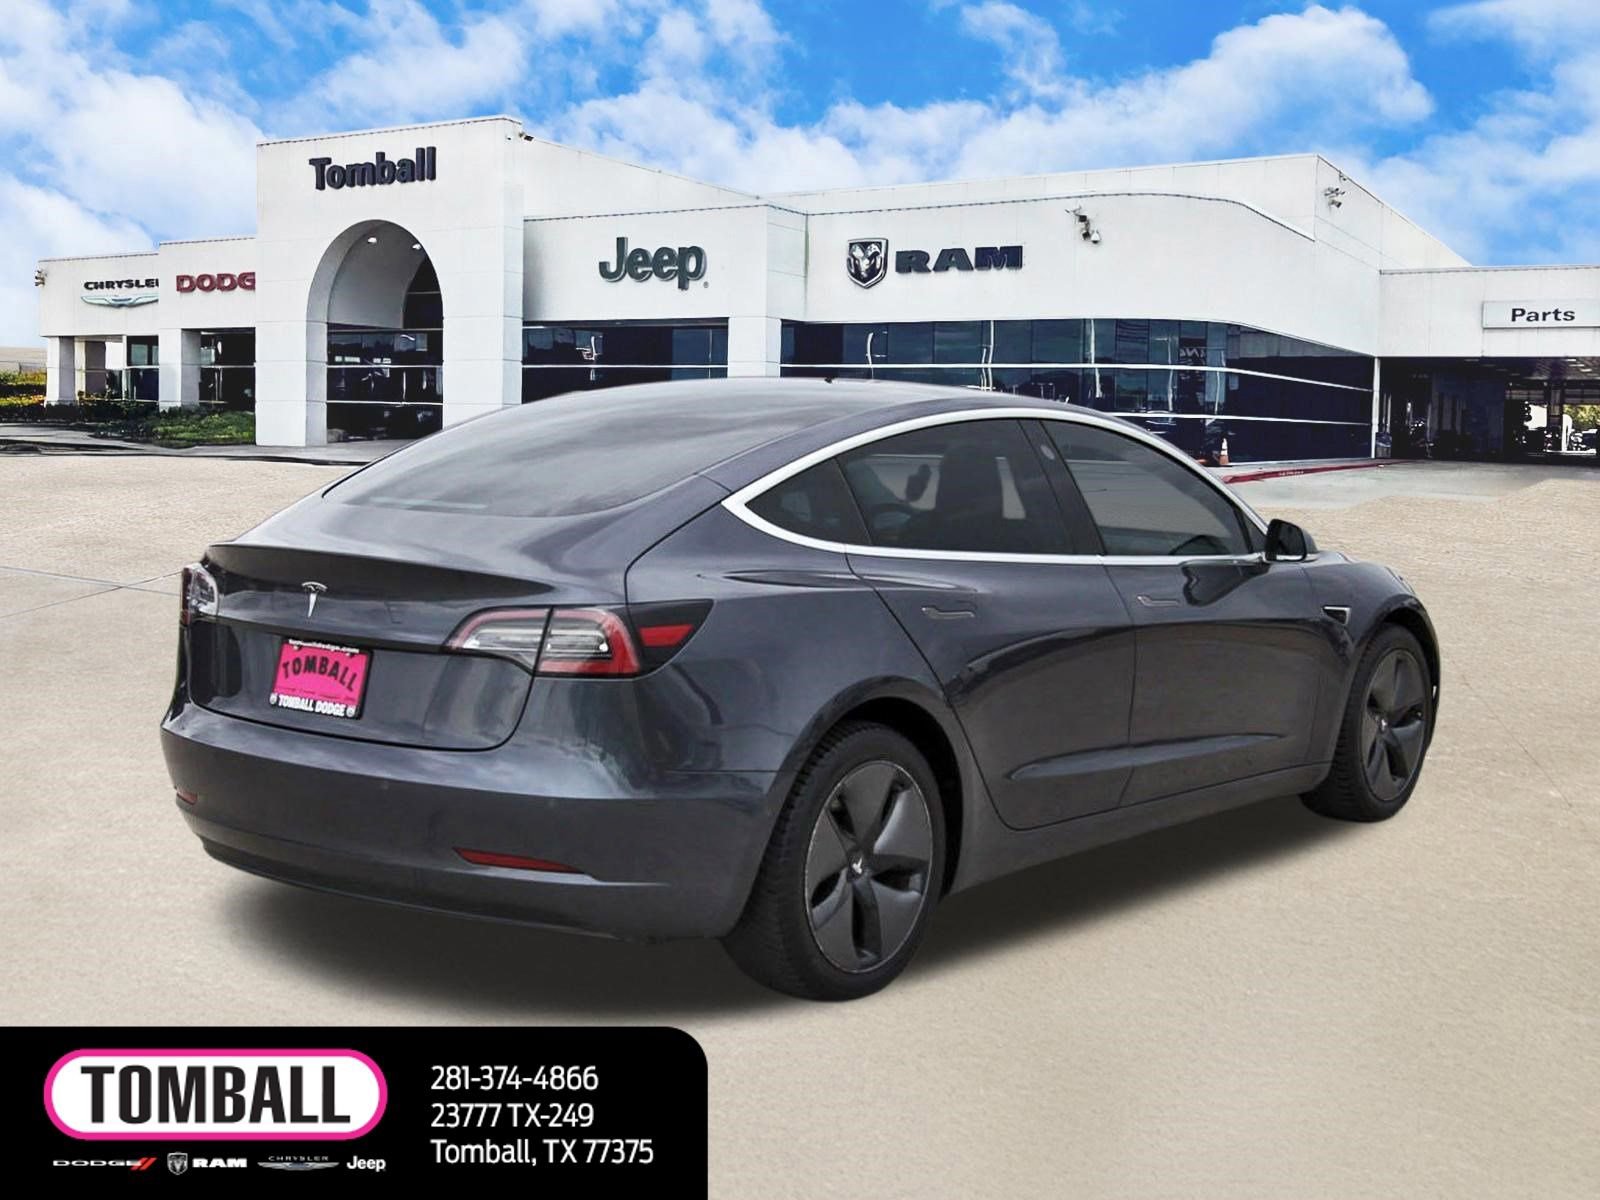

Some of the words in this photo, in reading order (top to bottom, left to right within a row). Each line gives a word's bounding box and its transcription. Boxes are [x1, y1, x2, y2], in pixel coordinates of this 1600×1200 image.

[309, 146, 436, 191] Tomball
[598, 236, 707, 290] Jeep
[895, 245, 1023, 274] RAM
[1511, 308, 1576, 322] Parts
[282, 656, 357, 691] TOMBALL
[279, 694, 314, 711] TOMBALL
[315, 700, 346, 717] DODGE
